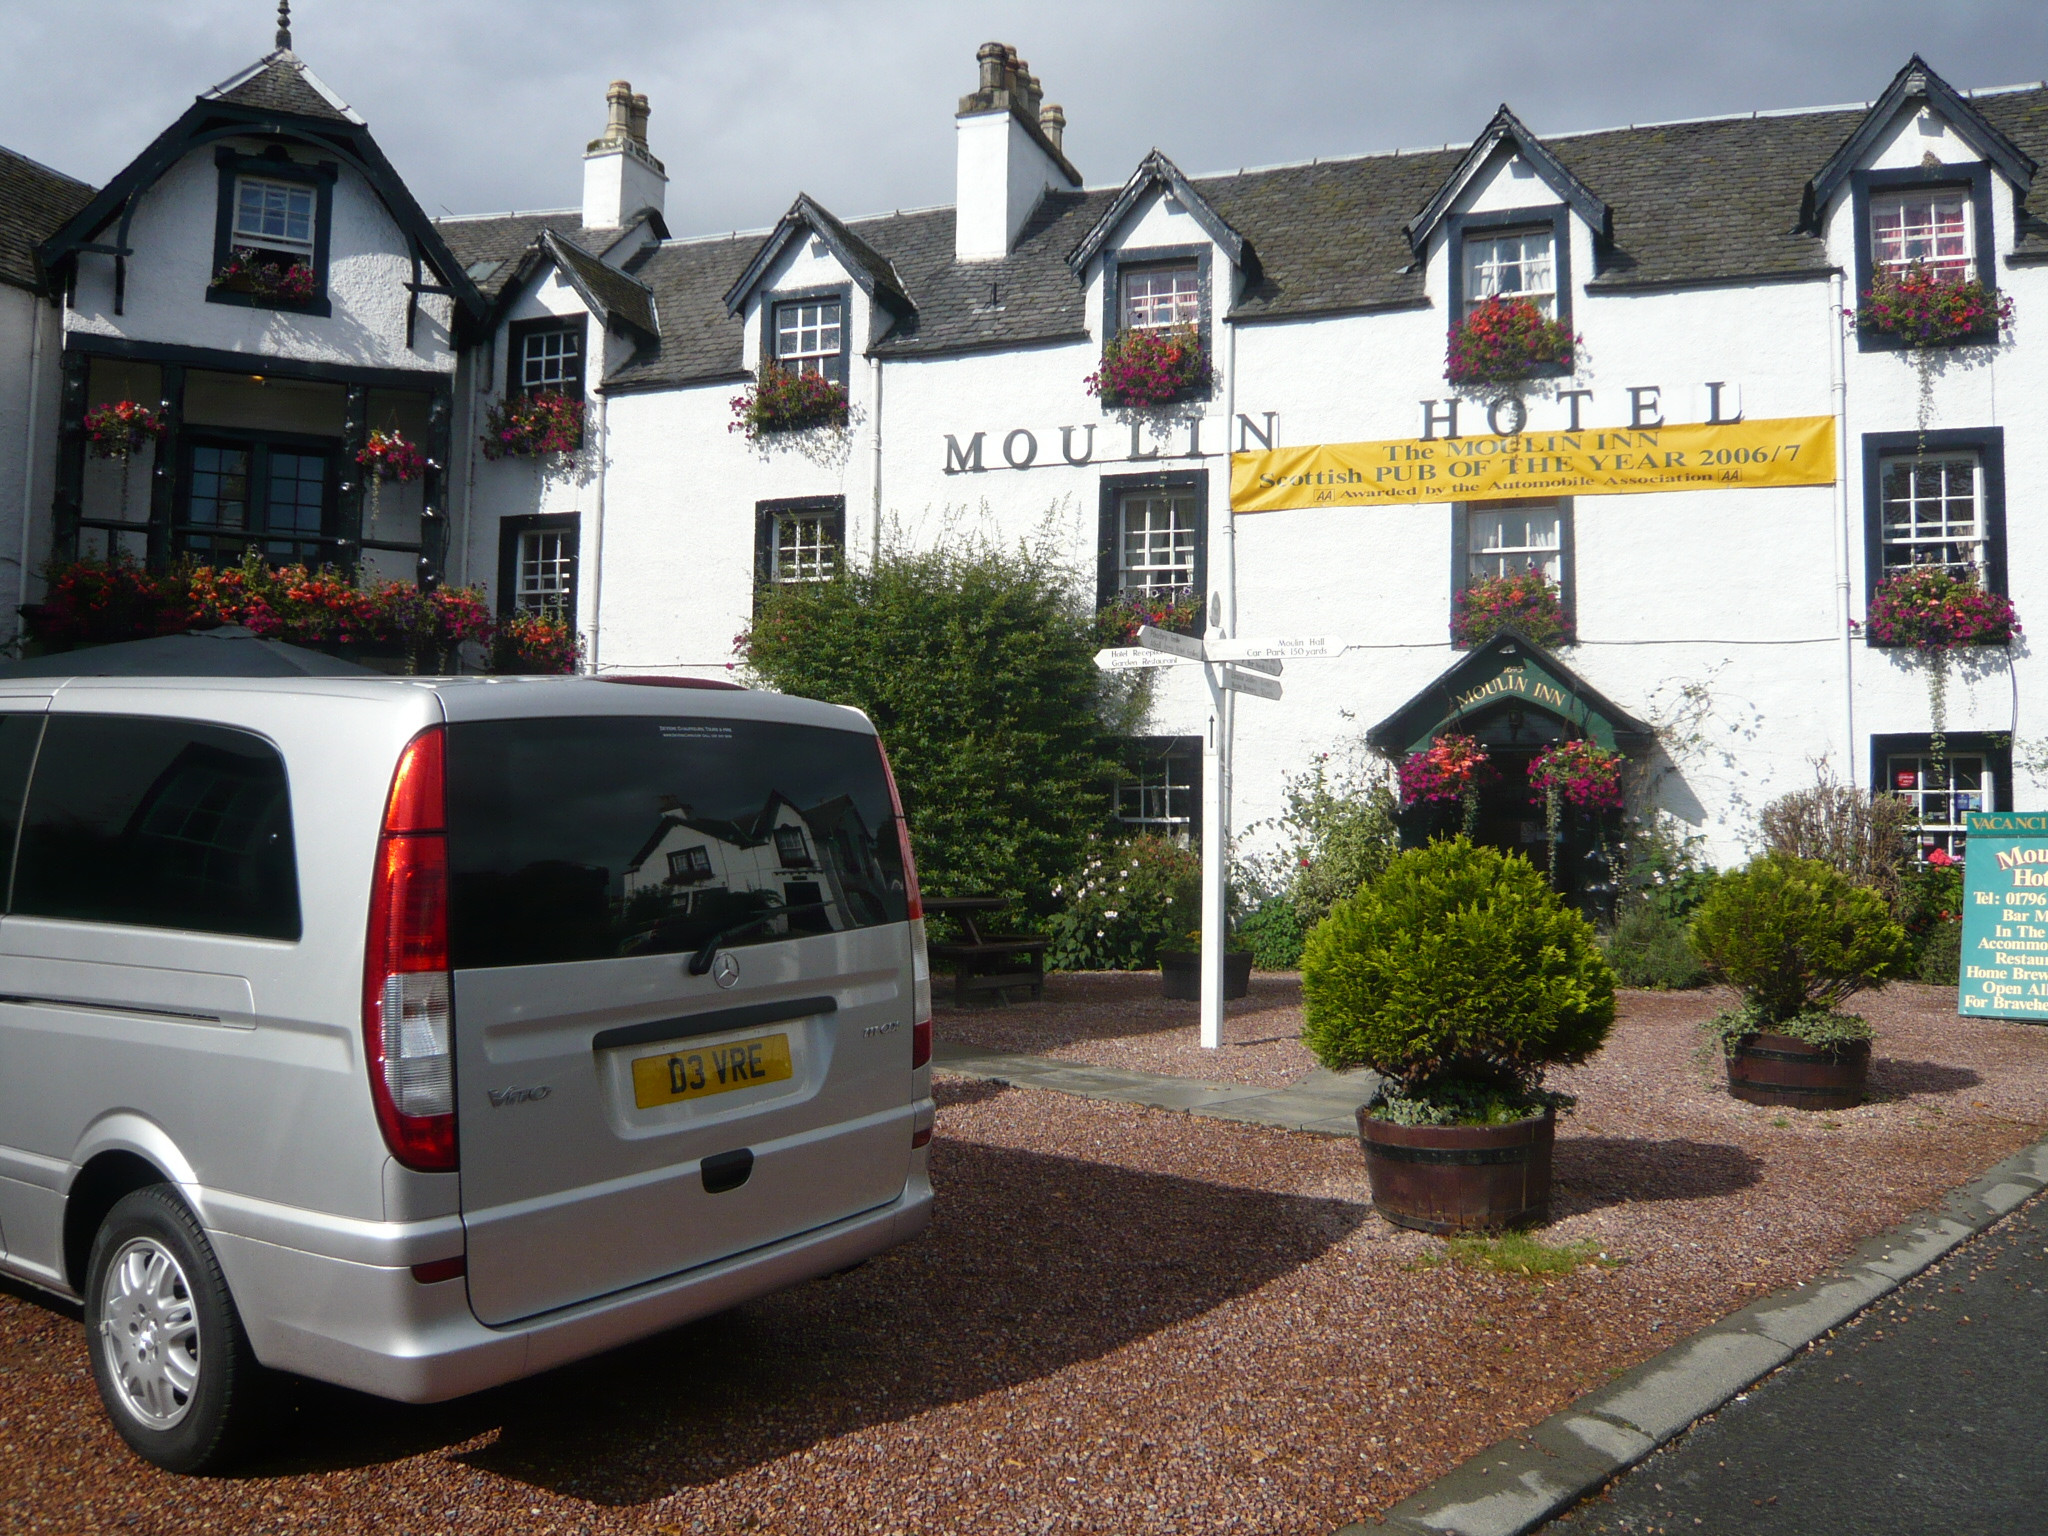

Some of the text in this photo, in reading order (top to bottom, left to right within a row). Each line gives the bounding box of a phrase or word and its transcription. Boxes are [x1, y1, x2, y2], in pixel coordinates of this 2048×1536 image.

[943, 382, 1745, 474] MOULIN HOTEL
[1383, 432, 1659, 461] The MOULIN INN
[1260, 445, 1800, 488] Scottish PUB OF THE YEAR 2006/7
[1315, 470, 1739, 501] AA Awarded by the Automobile Association AA
[1278, 638, 1325, 647] Moulin Hall
[1111, 650, 1128, 658] Hotel
[1247, 649, 1262, 657] Car
[1266, 648, 1286, 656] Park
[1305, 647, 1328, 657] yards
[1112, 657, 1178, 667] Garden Restaurant
[1456, 675, 1566, 709] MOULIN INN
[1973, 891, 2047, 906] Tel: 01796
[2002, 909, 2030, 922] Bar
[1995, 925, 2046, 938] In The
[1966, 965, 2008, 979] Home
[1982, 981, 2022, 997] Open
[1964, 994, 1989, 1008] For
[667, 1043, 766, 1095] D3 VRE
